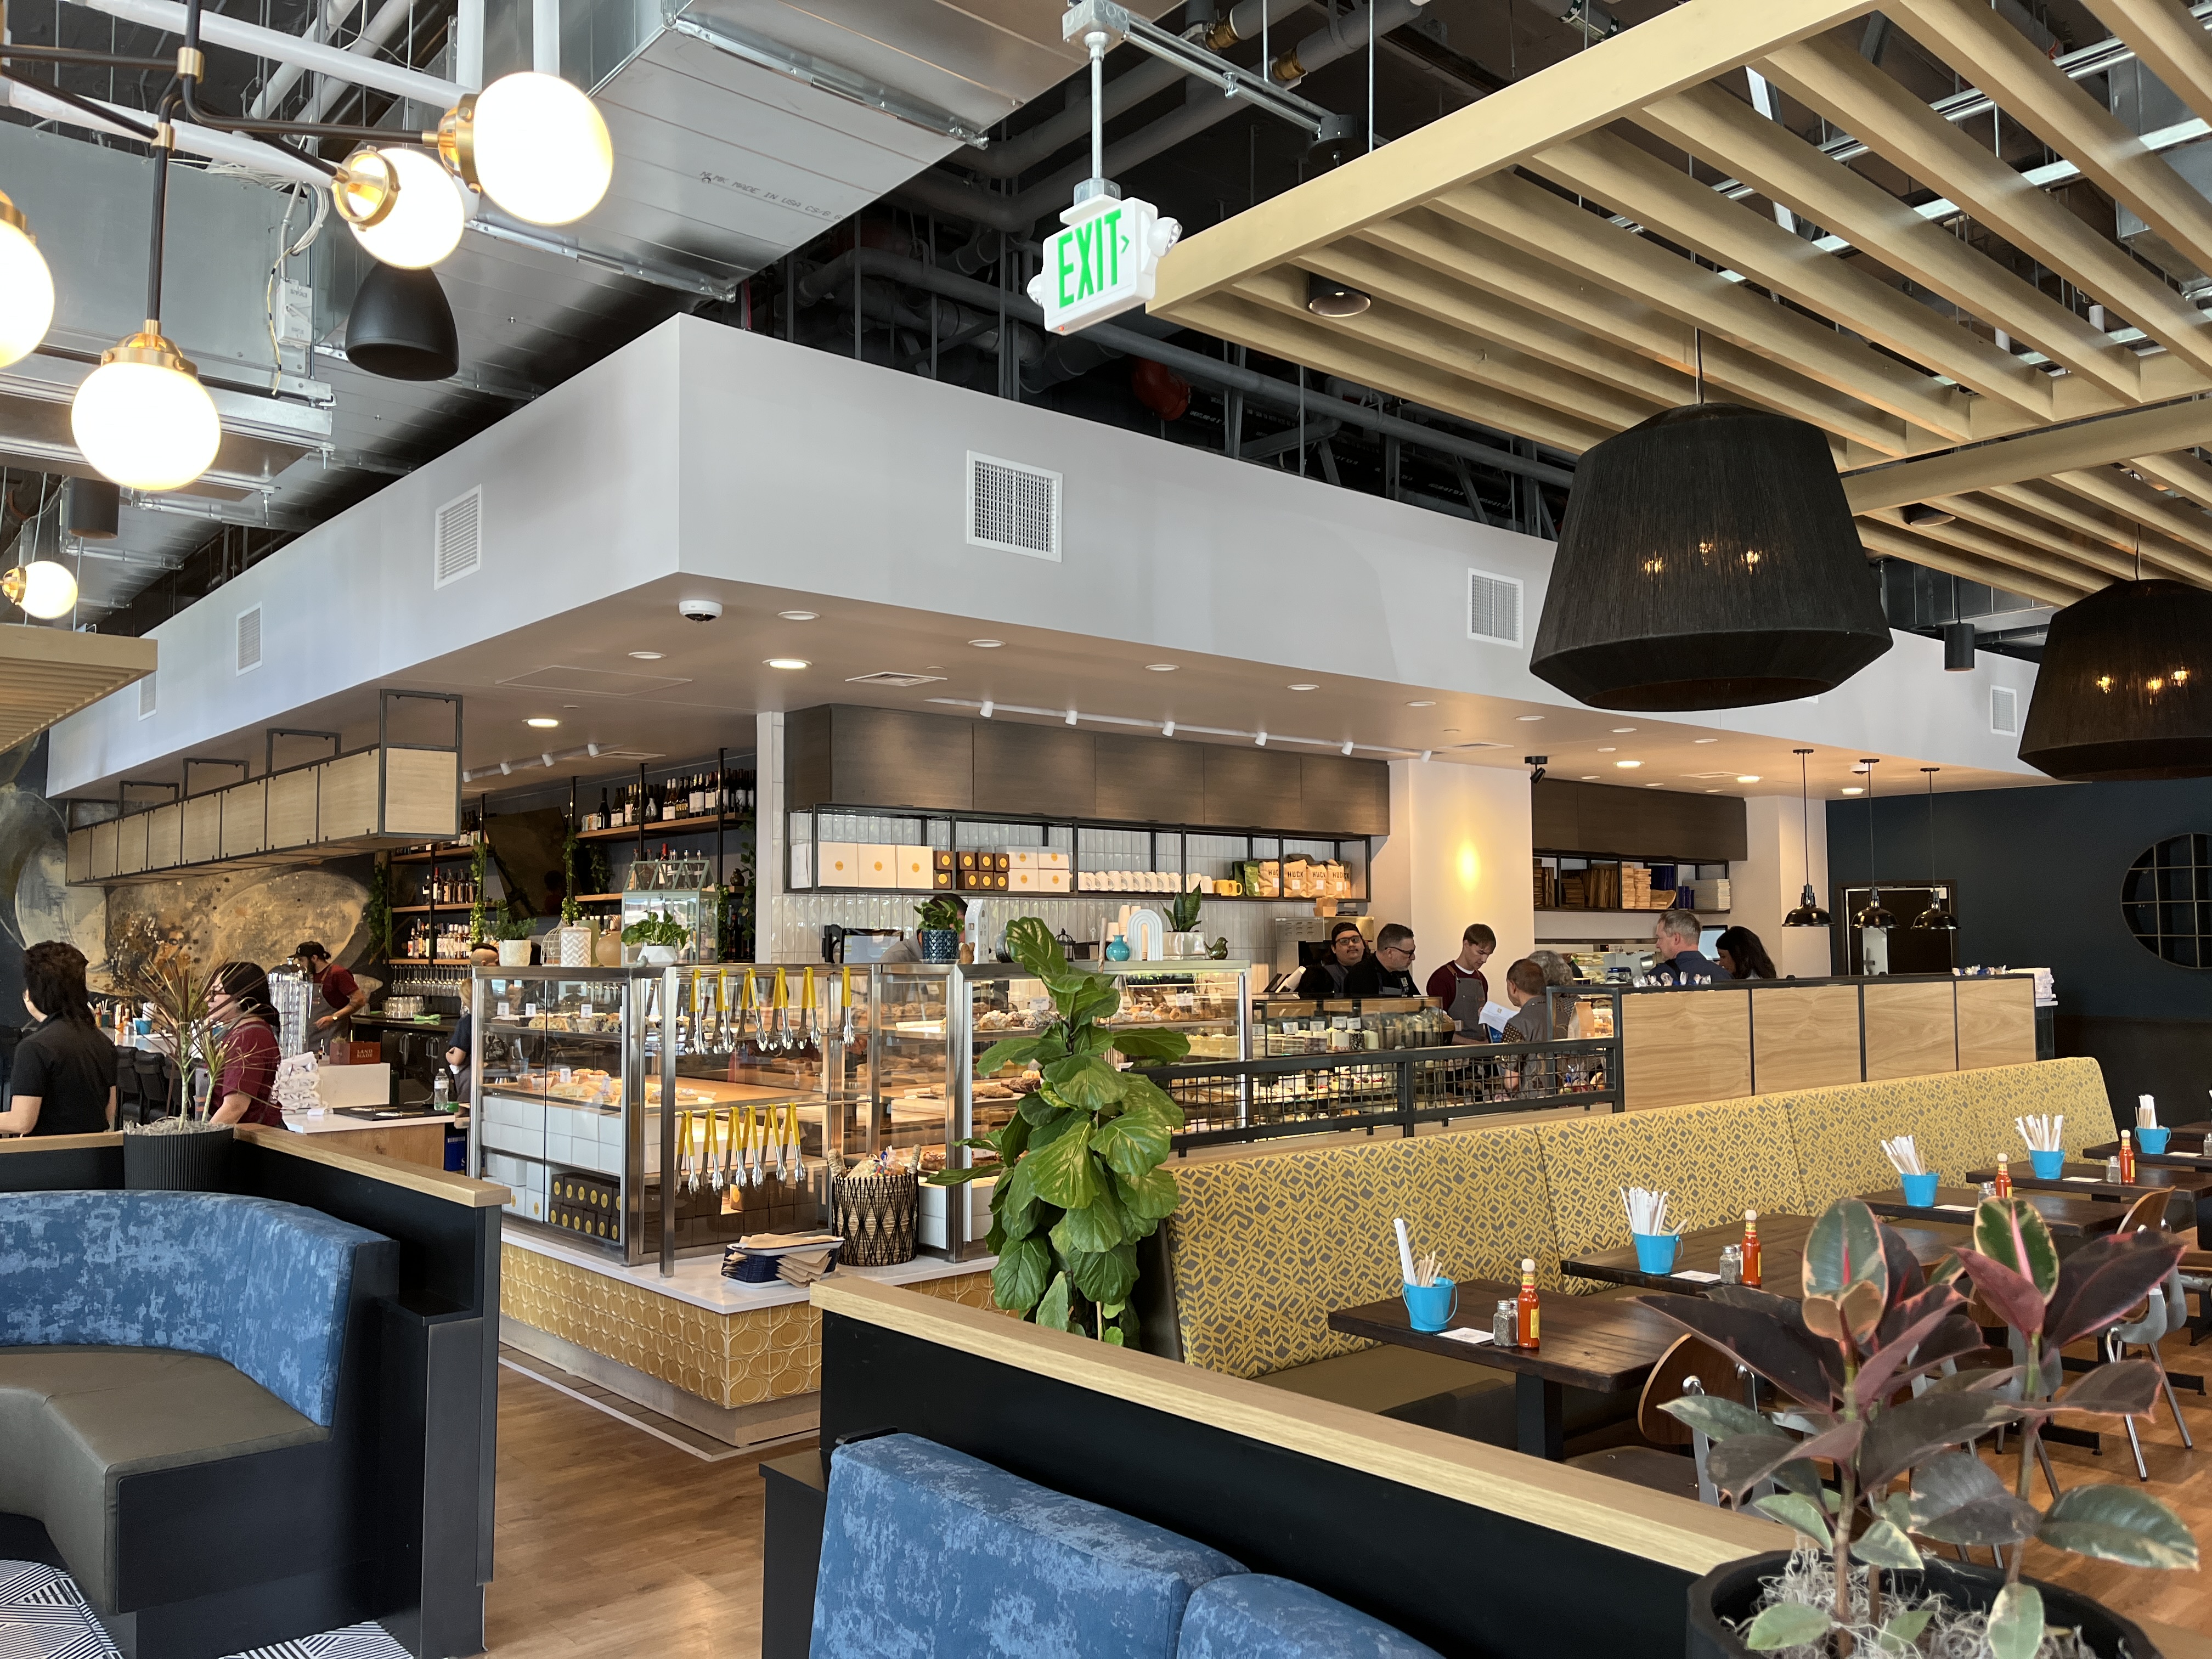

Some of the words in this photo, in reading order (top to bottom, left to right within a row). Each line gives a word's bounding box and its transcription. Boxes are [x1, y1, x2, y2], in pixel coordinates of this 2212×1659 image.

[732, 182, 760, 194] MADE
[781, 198, 802, 207] USA
[1058, 208, 1121, 309] EXIT
